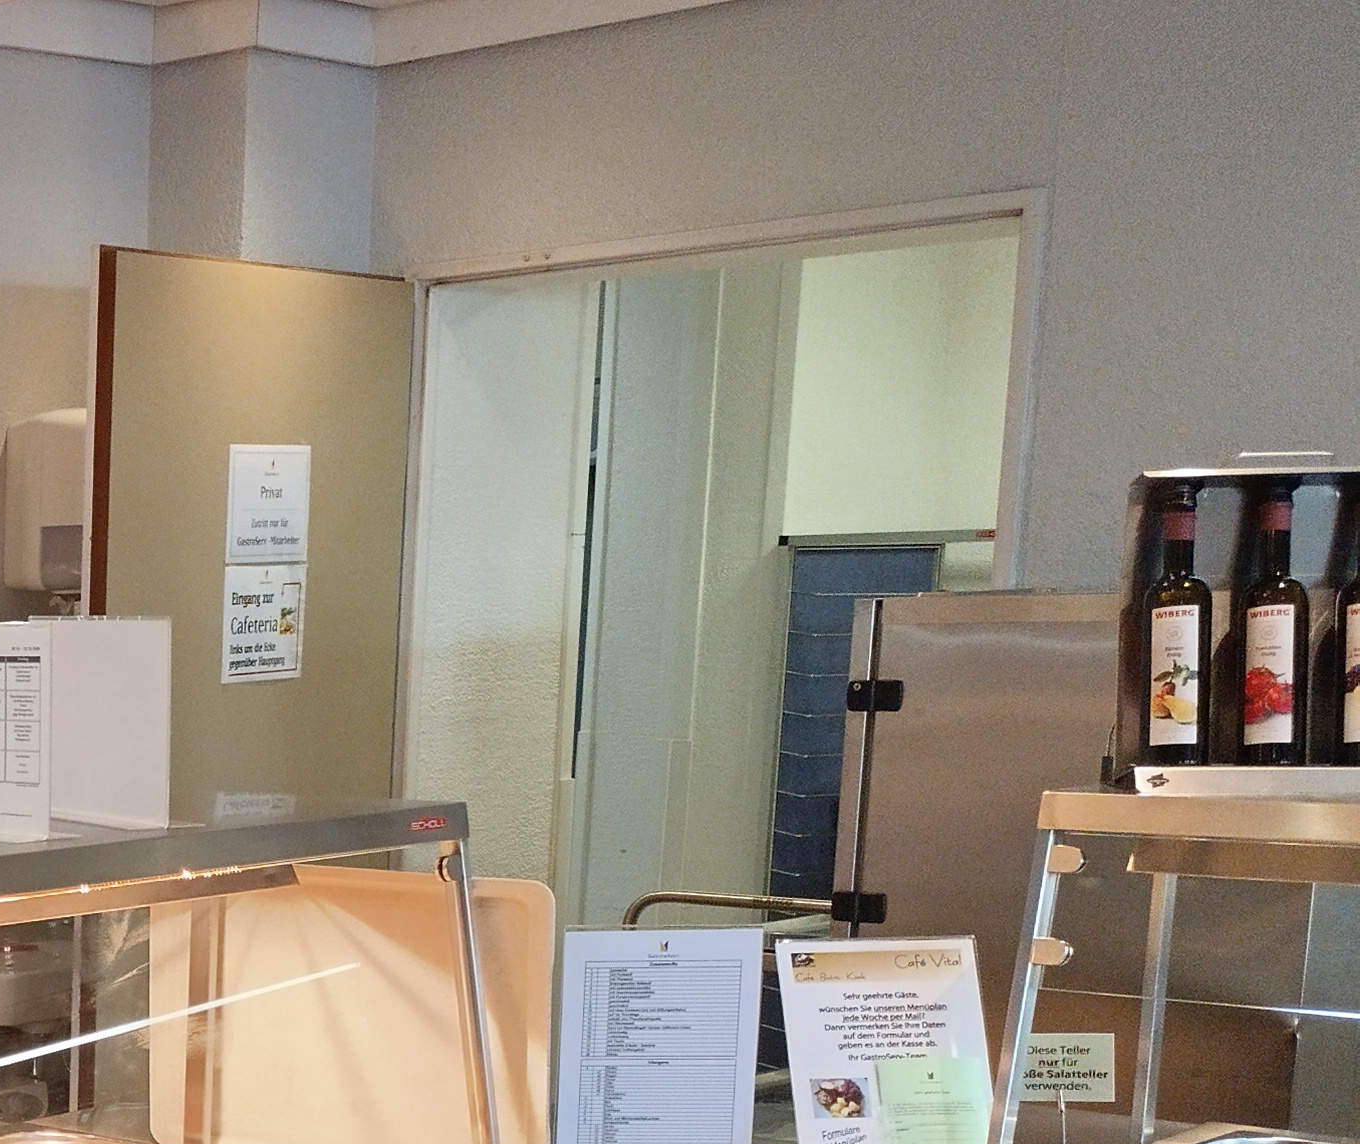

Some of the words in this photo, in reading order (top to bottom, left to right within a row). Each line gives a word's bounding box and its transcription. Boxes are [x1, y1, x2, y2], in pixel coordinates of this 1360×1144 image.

[260, 485, 283, 499] Privat
[231, 592, 261, 608] Eingang
[262, 592, 275, 604] zur
[1154, 609, 1195, 620] WIBERG
[1249, 609, 1290, 619] WIBERG
[231, 615, 278, 635] Cafeteria
[893, 953, 927, 970] Café
[930, 952, 963, 968] Vital
[843, 992, 861, 1000] Sehr
[862, 992, 894, 1001] geehrte
[818, 1005, 859, 1013] wünschen
[860, 1004, 872, 1012] Sie
[907, 1003, 948, 1013] Menüplan
[842, 1014, 860, 1023] jede
[861, 1013, 889, 1022] Woche
[905, 1012, 926, 1021] Mail?
[847, 1022, 890, 1030] vermerken
[891, 1022, 904, 1030] Sie
[905, 1021, 920, 1029] Ihre
[921, 1021, 946, 1029] Daten
[843, 1032, 856, 1040] auf
[857, 1032, 875, 1040] dem
[876, 1031, 913, 1039] Formular
[913, 1030, 930, 1038] und
[837, 1041, 864, 1050] geben
[886, 1040, 900, 1048] der
[1027, 1045, 1057, 1055] Diese
[1060, 1045, 1091, 1055] Teller
[848, 1053, 859, 1061] Ihr
[1038, 1059, 1060, 1068] nur
[1062, 1057, 1078, 1067] für
[1046, 1070, 1109, 1079] Salatteller
[1024, 1081, 1092, 1091] verwenden.
[821, 1125, 861, 1142] Formulare
